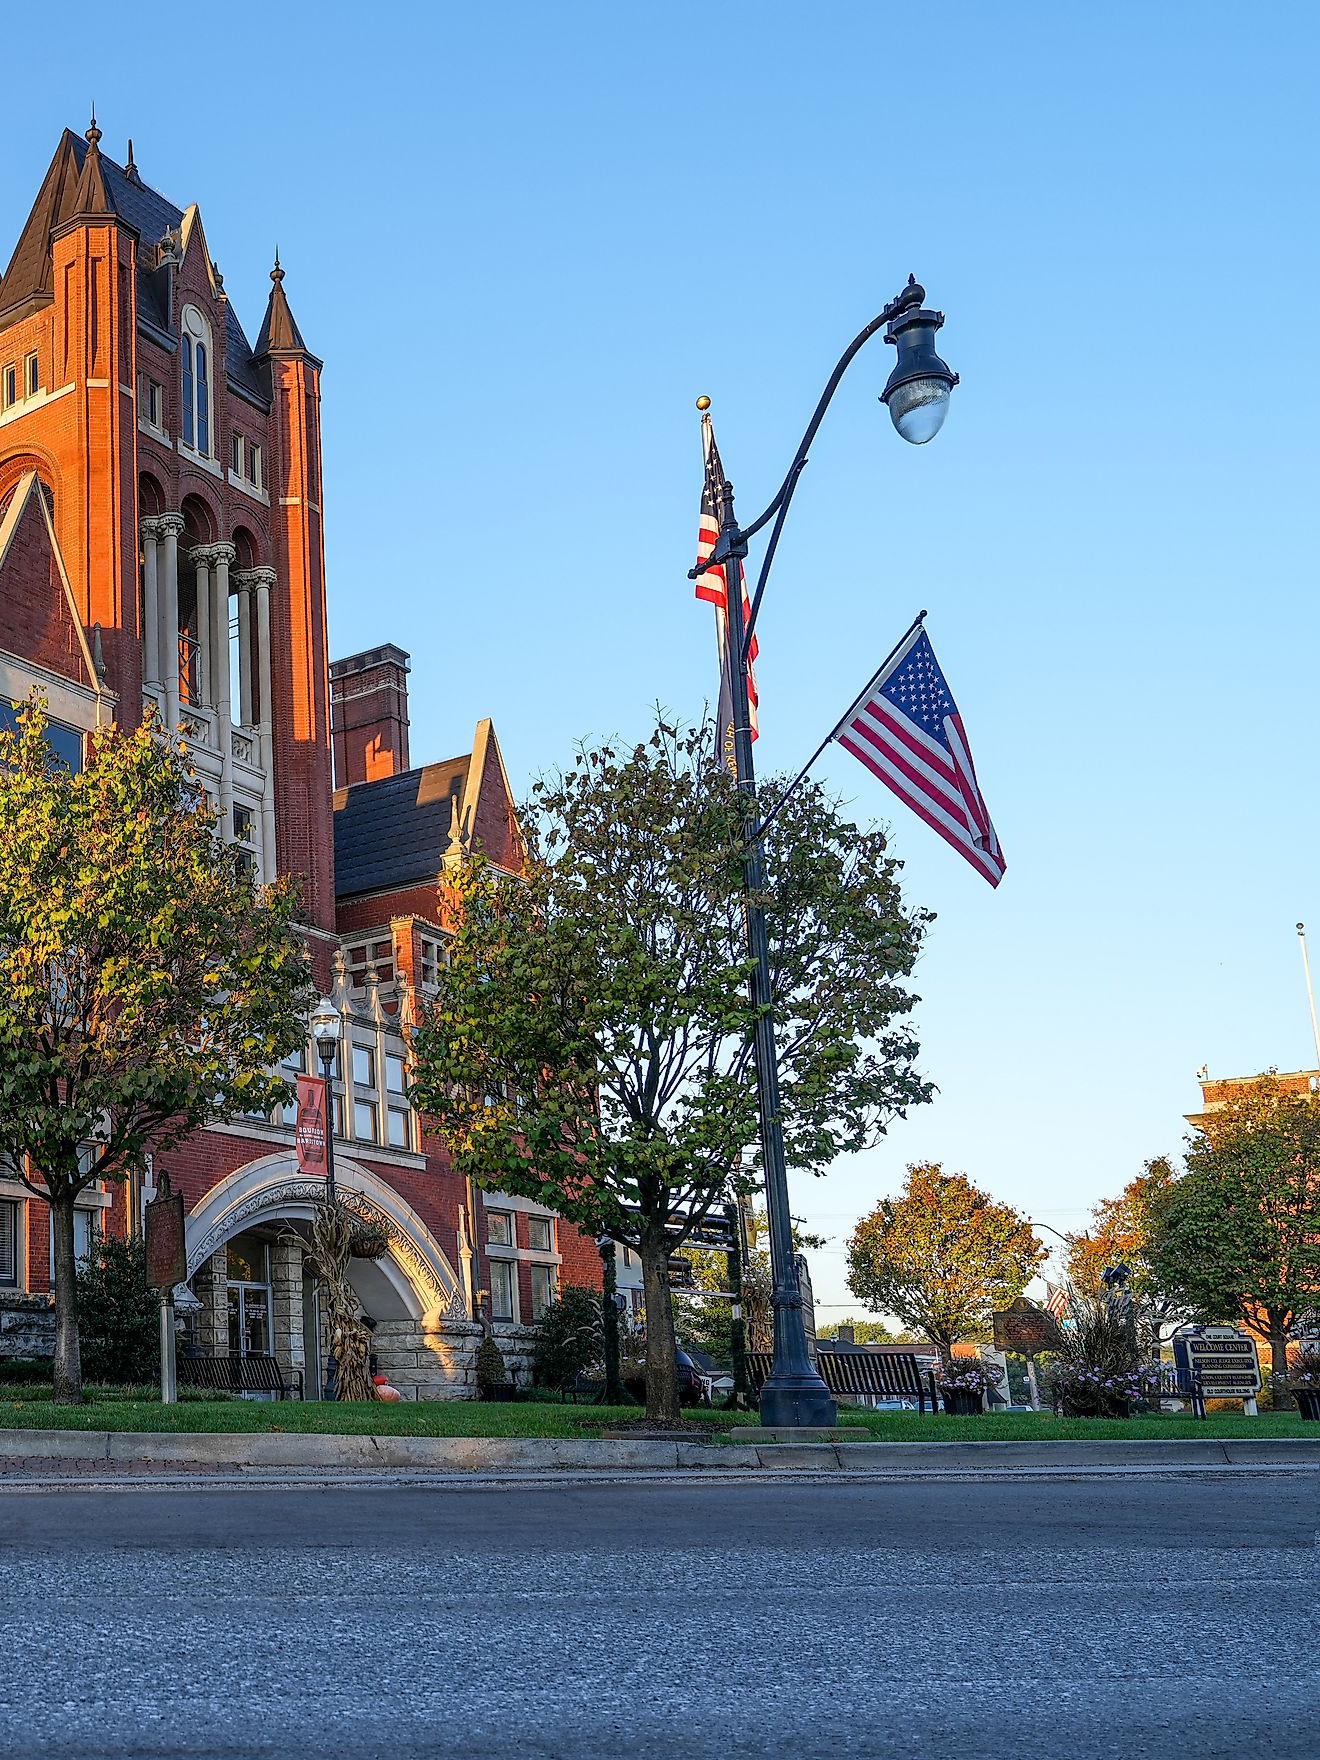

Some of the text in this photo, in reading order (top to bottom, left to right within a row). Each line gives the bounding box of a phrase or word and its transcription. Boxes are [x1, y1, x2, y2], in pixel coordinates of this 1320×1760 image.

[724, 741, 734, 753] OF
[1193, 1343, 1249, 1352] WELCOME CENTER
